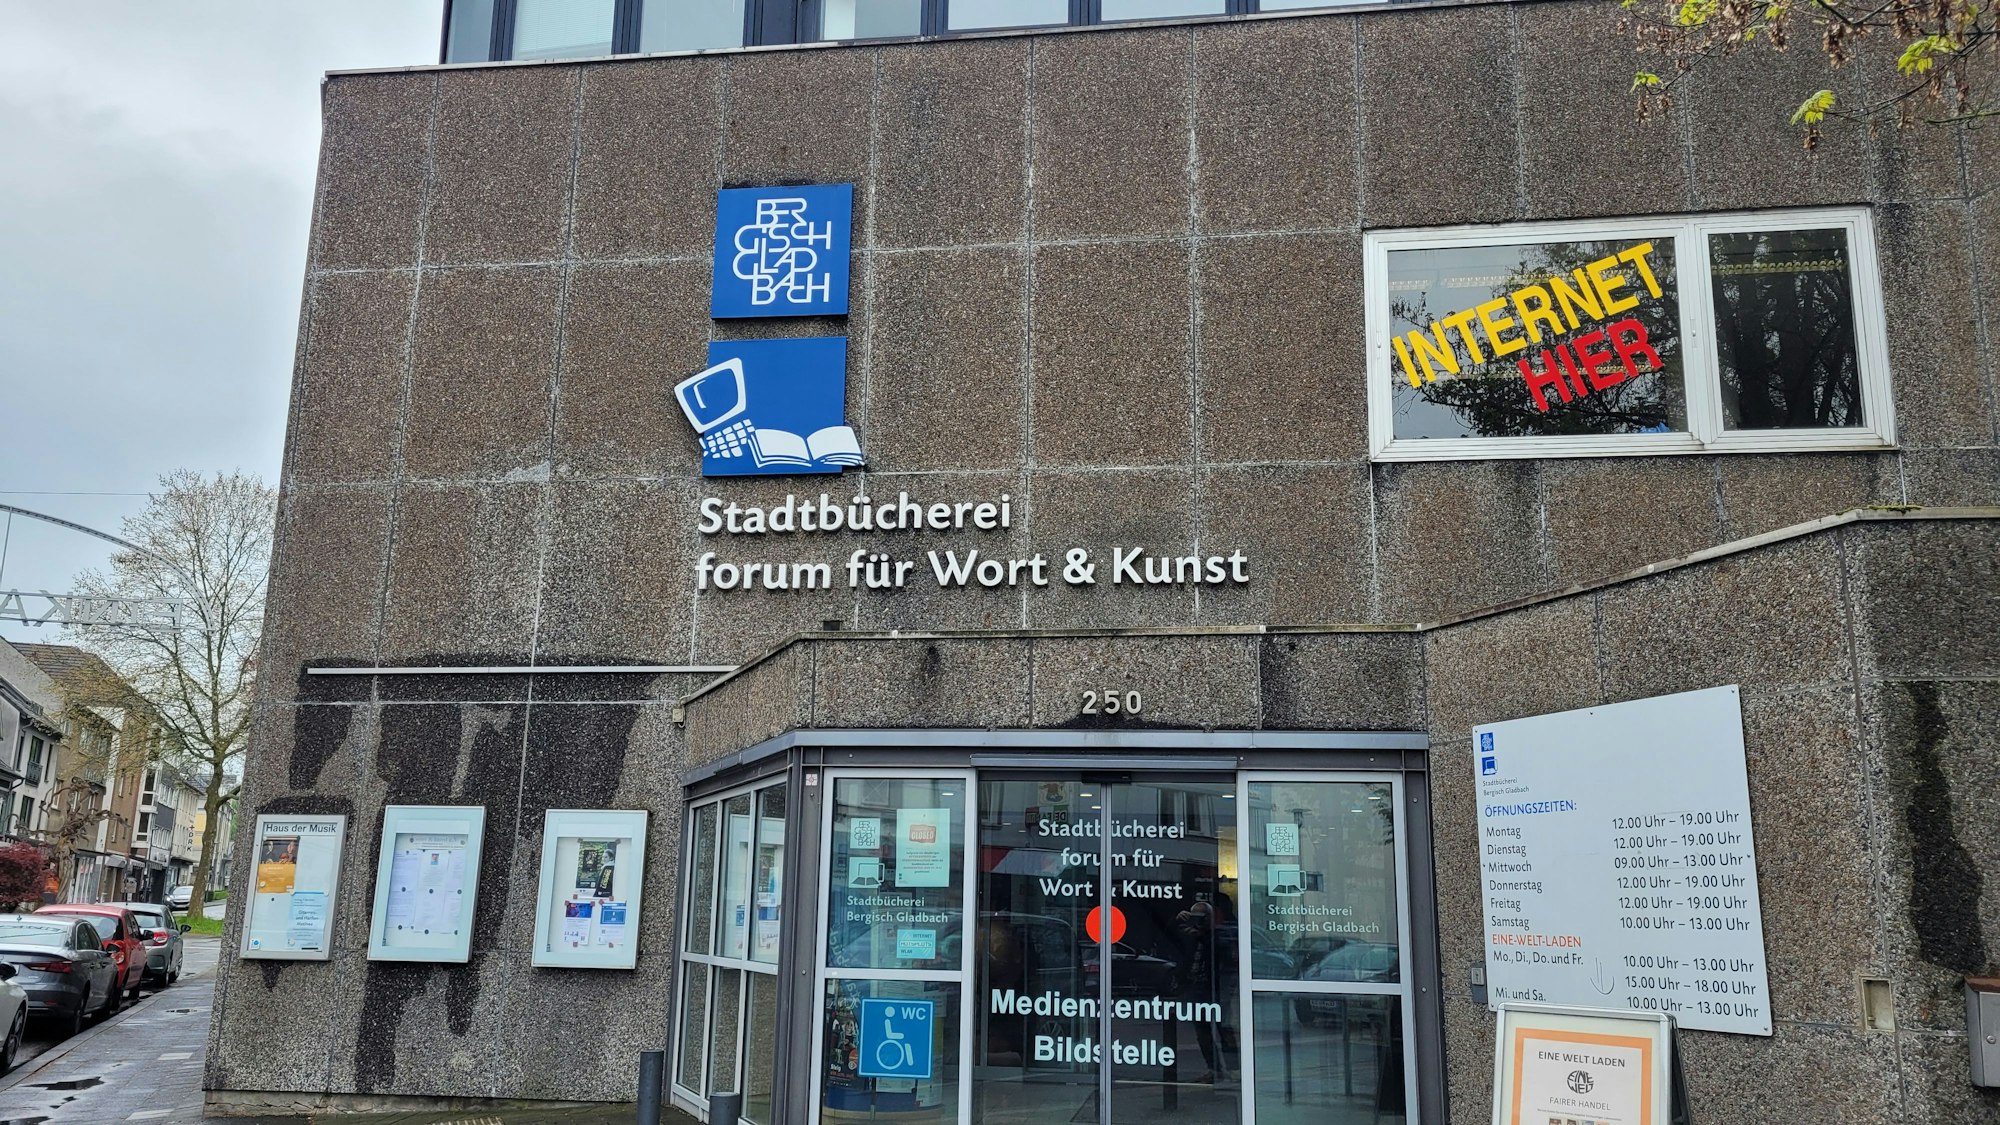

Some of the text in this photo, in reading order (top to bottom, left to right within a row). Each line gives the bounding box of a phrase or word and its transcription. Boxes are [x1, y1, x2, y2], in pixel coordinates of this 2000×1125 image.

[1391, 242, 1664, 390] INTERNET
[1517, 318, 1665, 413] HIER
[698, 492, 1010, 534] Stadtbücherei
[696, 546, 1249, 590] forum für Wort & Kunst
[1082, 690, 1142, 714] 250
[1482, 777, 1518, 787] Stadtbücherei
[1483, 786, 1529, 797] Bergisch Gladbach
[1485, 800, 1577, 817] ÖFFNUNGSZEITEN:
[265, 824, 337, 833] Haus der Musik
[1039, 819, 1185, 838] Stadtbücherei
[1486, 826, 1521, 839] Montag
[1612, 817, 1641, 829] 12.00
[1644, 815, 1665, 828] Uhr
[1680, 812, 1712, 825] 19.00
[1715, 811, 1739, 824] Uhr
[911, 831, 935, 840] CLOSED
[1487, 844, 1526, 857] Dienstag
[1614, 836, 1643, 849] 12.00
[1646, 835, 1667, 847] Uhr
[1682, 833, 1713, 846] 19.00
[1717, 831, 1741, 844] Uhr
[1061, 847, 1164, 867] forum für
[1488, 861, 1532, 873] Mittwoch
[1615, 856, 1644, 869] 09.00
[1648, 855, 1669, 867] Uhr
[1683, 854, 1715, 866] 13.00
[1720, 853, 1743, 865] Uhr
[1039, 878, 1093, 897] Wort
[1122, 880, 1183, 899] Kunst
[1489, 880, 1542, 893] Donnerstag
[1617, 877, 1646, 889] 12.00
[1650, 876, 1671, 888] Uhr
[1685, 875, 1717, 888] 19.00
[1722, 875, 1745, 887] Uhr
[847, 896, 925, 907] Stadtbücherei
[1268, 904, 1352, 916] Stadtbücherei
[1490, 898, 1521, 912] Freitag
[1619, 897, 1648, 909] 12.00
[1651, 897, 1672, 908] Uhr
[1687, 897, 1720, 909] 19.00
[1724, 896, 1747, 908] Uhr
[847, 912, 948, 924] Bergisch Gladbach
[1491, 916, 1529, 930] Samstag
[1620, 917, 1650, 929] 10.00
[1653, 917, 1674, 929] Uhr
[1689, 917, 1722, 930] 13.00
[1726, 918, 1750, 930] Uhr
[1269, 921, 1380, 934] Bergisch Gladbach
[1492, 934, 1582, 948] EINE-WELT-LADEN
[1493, 950, 1513, 964] Mo.,
[1515, 951, 1531, 965] Di.,
[1551, 953, 1570, 965] und
[1572, 954, 1584, 965] Fr.
[1624, 956, 1653, 968] 10.00
[1657, 956, 1678, 969] Uhr
[1693, 958, 1726, 971] 13.00
[1730, 959, 1754, 972] Uhr
[1625, 976, 1655, 988] 15.00
[1658, 977, 1680, 990] Uhr
[1695, 980, 1728, 993] 18.00
[1732, 981, 1756, 995] Uhr
[1495, 987, 1511, 999] Mi.
[1512, 989, 1531, 1000] und
[1532, 990, 1546, 1002] Sa.
[1627, 997, 1657, 1009] 10.00
[1660, 998, 1682, 1011] Uhr
[1697, 1001, 1730, 1015] 13.00
[1734, 1003, 1759, 1018] Uhr
[902, 1007, 926, 1020] WC
[1035, 1036, 1175, 1066] Bildstelle
[1538, 1051, 1625, 1067] EINE WELT LADEN
[1567, 1070, 1594, 1083] EINE
[1567, 1080, 1594, 1094] WELT
[1550, 1097, 1611, 1111] FAIRER HANDEL
